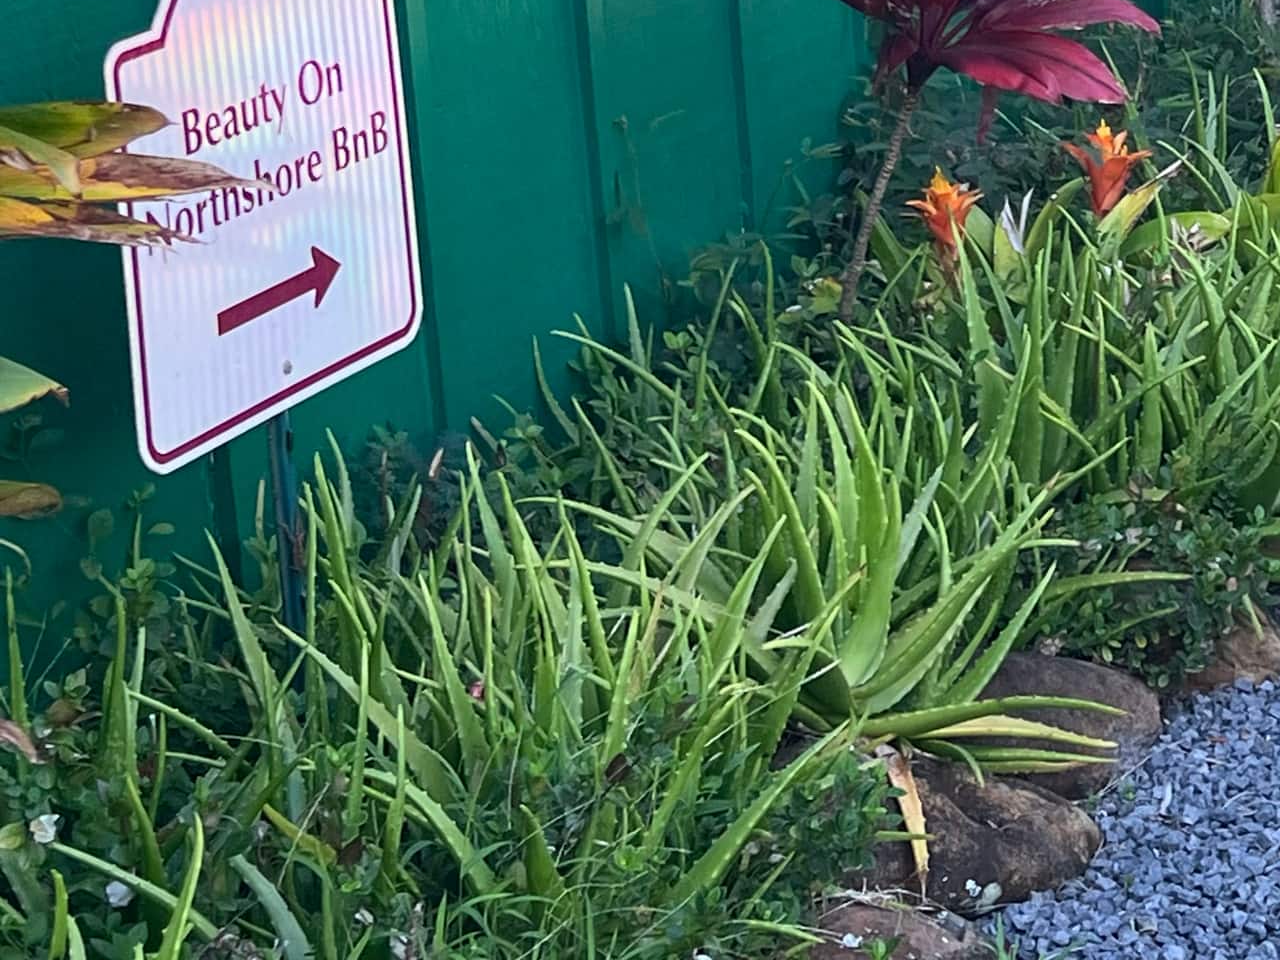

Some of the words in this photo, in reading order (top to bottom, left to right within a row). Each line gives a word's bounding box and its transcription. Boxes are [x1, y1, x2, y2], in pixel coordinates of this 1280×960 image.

[182, 83, 286, 155] Beauty
[298, 60, 343, 105] On
[332, 111, 388, 171] BnB
